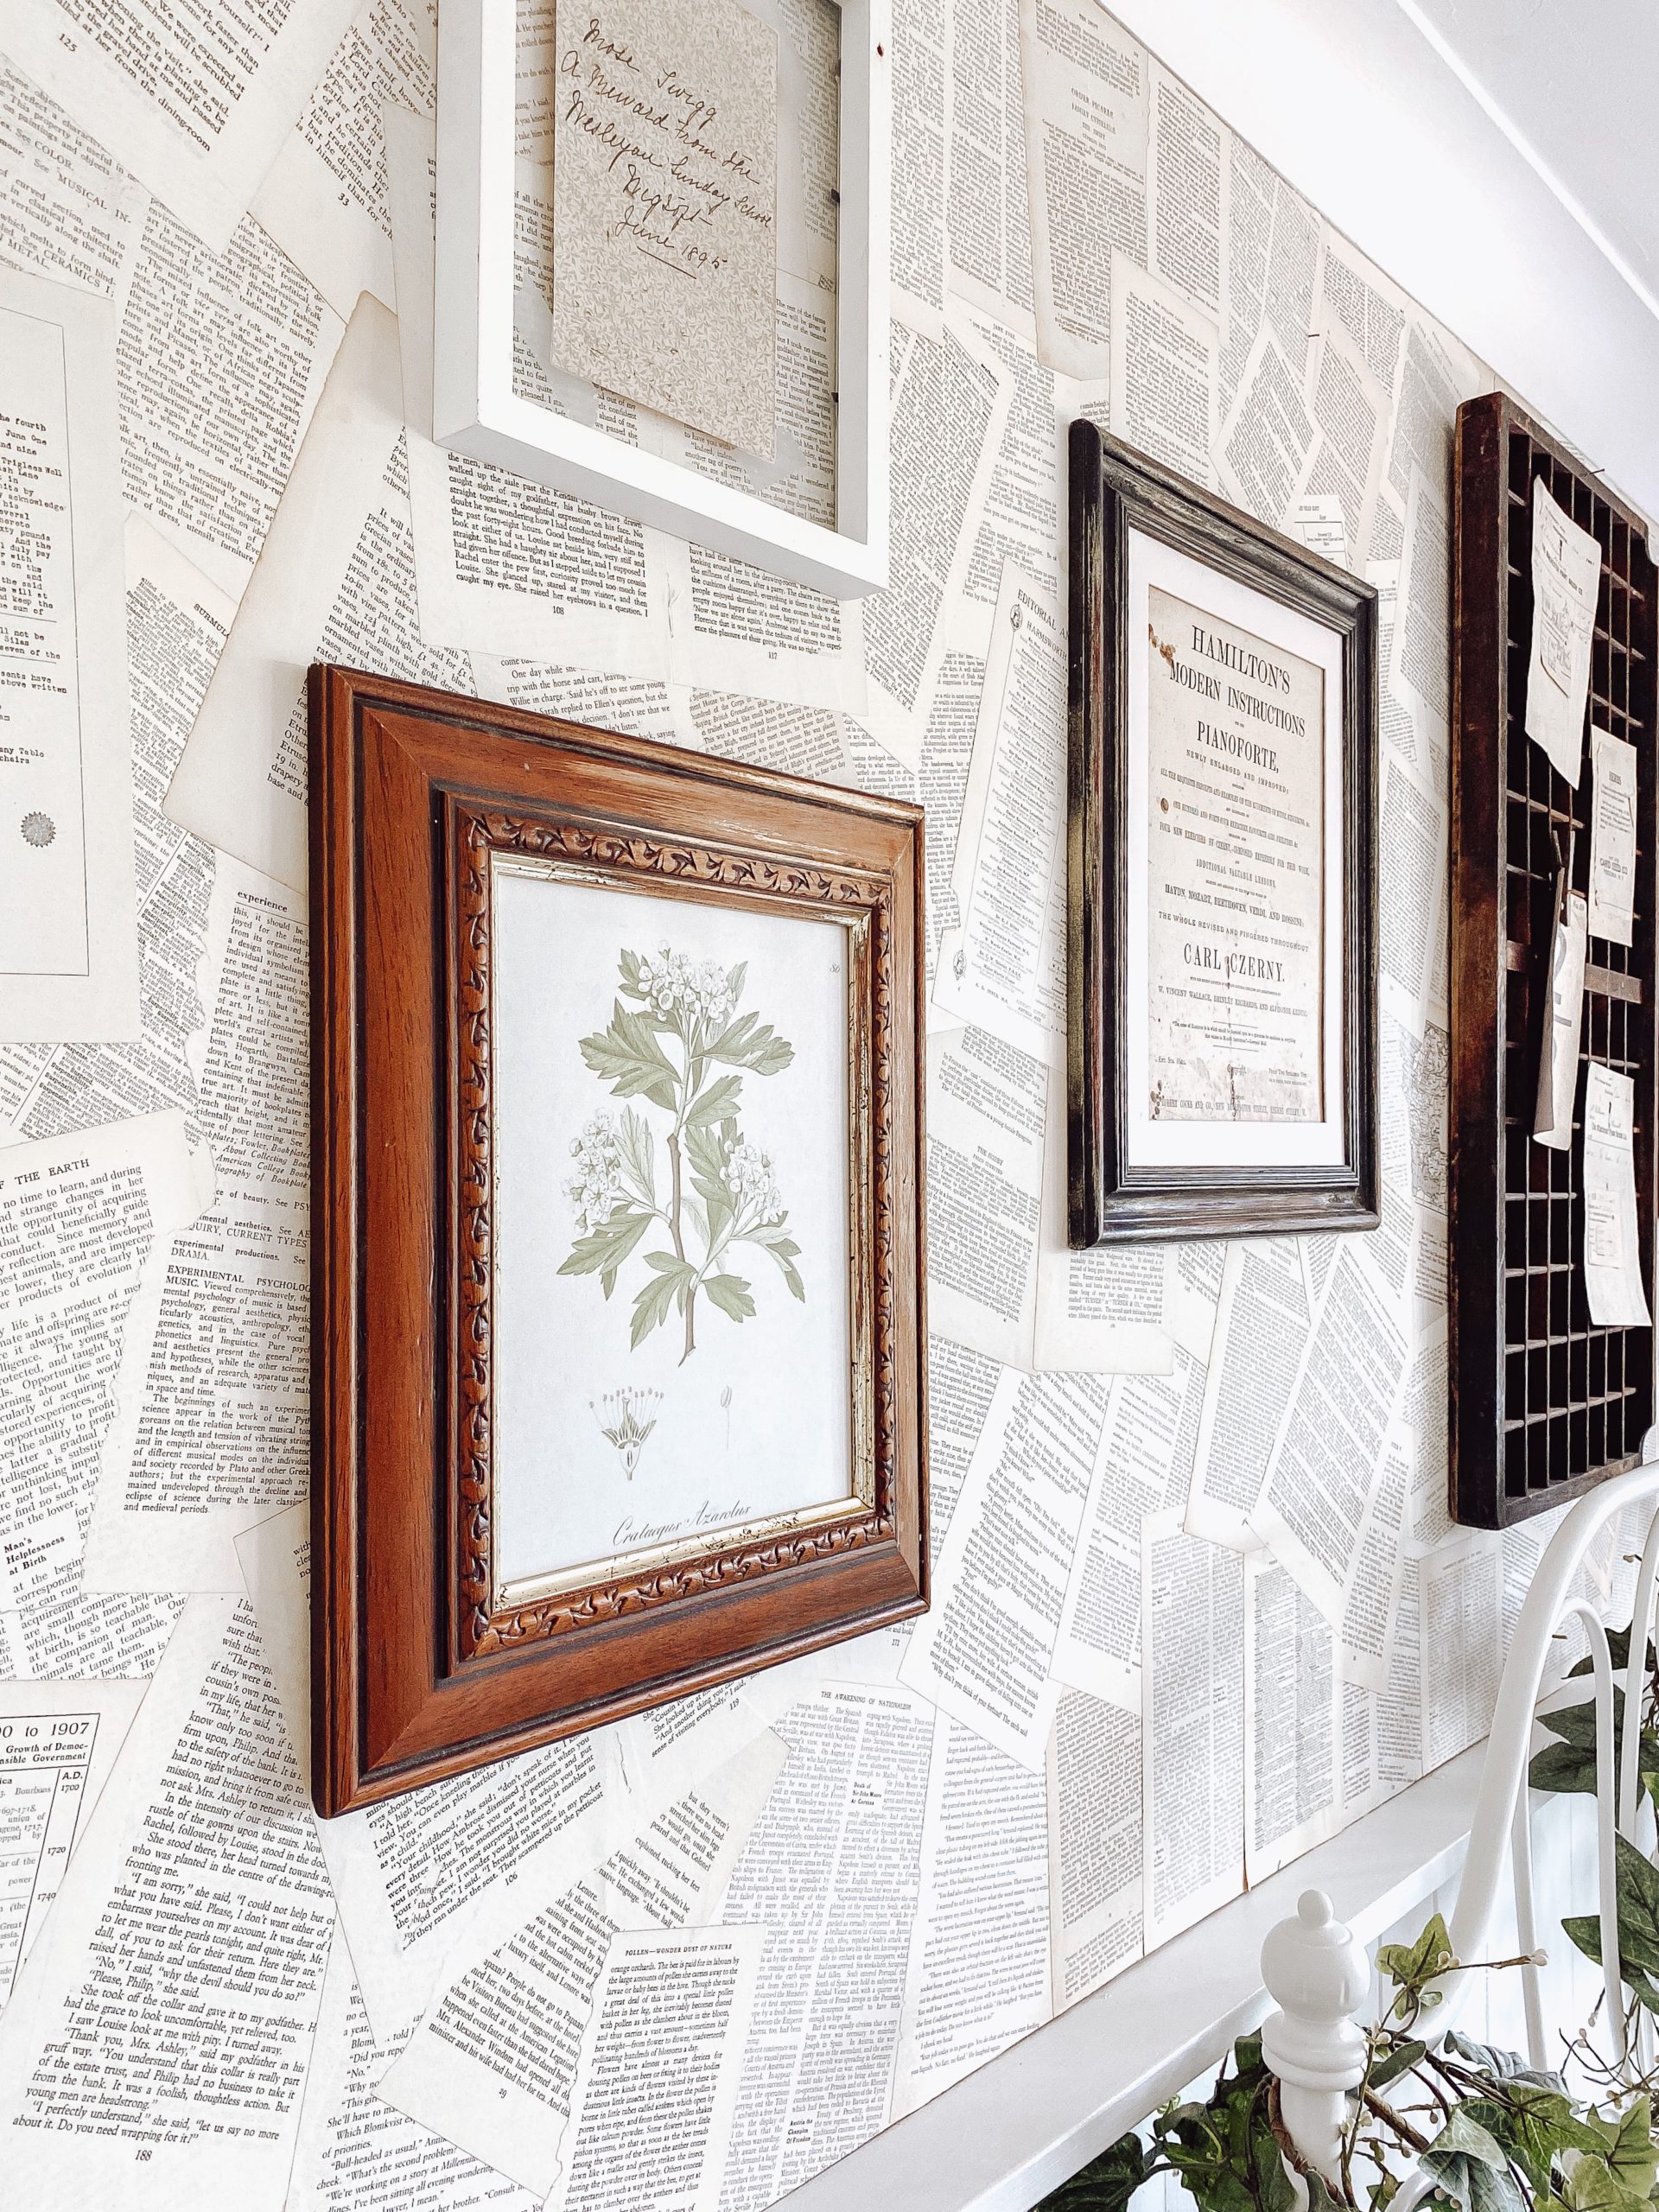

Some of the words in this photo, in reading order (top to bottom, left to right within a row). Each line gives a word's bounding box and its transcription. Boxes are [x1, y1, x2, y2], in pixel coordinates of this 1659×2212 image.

[59, 33, 78, 53] 125
[95, 34, 112, 53] her
[114, 53, 137, 80] from
[141, 79, 156, 97] the
[158, 96, 211, 152] dining-room
[16, 128, 31, 145] See
[35, 140, 74, 172] COLOR.
[316, 145, 347, 181] himself
[347, 183, 365, 206] than
[338, 157, 377, 204] dominates
[57, 173, 107, 210] MUSICAL
[338, 193, 350, 206] 33
[671, 156, 730, 215] Sunday
[734, 196, 772, 228] School
[615, 205, 674, 248] June
[682, 244, 728, 270] 1895
[16, 418, 47, 432] fourth
[6, 429, 26, 441] June
[31, 435, 47, 446] One
[16, 444, 37, 456] nine
[18, 467, 39, 480] Lane
[23, 487, 34, 497] by
[9, 493, 64, 512] acknowledge
[21, 531, 51, 542] pounds
[36, 541, 51, 550] the
[10, 544, 30, 556] duly
[36, 550, 50, 559] pay
[456, 574, 480, 584] caught
[483, 579, 494, 588] my
[514, 583, 527, 593] She
[530, 588, 550, 597] raised
[553, 591, 563, 600] her
[567, 595, 596, 607] eyebrows
[615, 606, 642, 615] question.
[553, 606, 565, 615] 108
[1018, 588, 1057, 631] EDITORIAL
[719, 629, 741, 639] pleasure
[1027, 620, 1067, 661] HARMSWORTH
[768, 652, 777, 660] 117
[1192, 625, 1290, 695] HAMILTON'S
[1170, 659, 1221, 702] MODERN
[1228, 686, 1306, 737] INSTRUCTIONS
[1197, 721, 1280, 773] PIANOFORTE,
[1186, 749, 1207, 764] NEWLY
[1210, 759, 1241, 776] ENLARGED
[1244, 772, 1255, 781] AND
[1196, 858, 1226, 874] ADDITIONAL
[237, 889, 288, 913] experience
[1165, 884, 1186, 898] HAYDN,
[1188, 890, 1212, 906] MOZART,
[1214, 897, 1247, 914] BEETHOVEN,
[1249, 906, 1267, 918] VERDI,
[1268, 911, 1280, 920] AND
[1159, 911, 1172, 921] THE
[1173, 913, 1196, 926] WHOLE
[1198, 920, 1224, 932] REVISED
[1226, 927, 1238, 936] AND
[1239, 930, 1268, 943] FINGERED
[1270, 938, 1309, 953] THROUGHOUT
[1184, 943, 1222, 970] CARL
[1230, 952, 1285, 982] CZERNY.
[1166, 987, 1186, 998] VINCENT
[1189, 990, 1211, 1002] WALLACE,
[15, 1171, 41, 1185] THE
[48, 1158, 90, 1177] EARTH
[3, 1200, 16, 1209] no
[20, 1193, 42, 1204] time
[60, 1182, 88, 1193] learn,
[91, 1174, 108, 1185] and
[111, 1166, 142, 1179] during
[226, 1228, 273, 1243] CURRENT
[277, 1236, 308, 1249] TYPES
[171, 1247, 210, 1261] DRAMA.
[174, 1238, 224, 1252] experimental
[235, 1248, 280, 1261] productions.
[293, 1255, 306, 1265] See
[168, 1265, 245, 1283] EXPERIMENTAL
[3, 1537, 33, 1554] Man's
[6, 1535, 65, 1565] Helplessness
[10, 1567, 18, 1575] at
[22, 1554, 47, 1570] Birth
[879, 1700, 912, 1711] NATIONALISM
[25, 1726, 38, 1738] to
[50, 1722, 89, 1737] 1907
[6, 1745, 40, 1754] Growth
[42, 1744, 53, 1752] of
[55, 1742, 88, 1751] Democ-
[33, 1751, 86, 1762] Government
[62, 1771, 83, 1781] A.D.
[61, 1783, 79, 1793] 1700
[499, 1858, 518, 1875] They
[518, 1830, 553, 1860] scampered
[554, 1822, 563, 1835] up
[563, 1815, 575, 1824] the
[576, 1792, 604, 1818] petticoat
[48, 1846, 66, 1855] 1720
[125, 1857, 162, 1875] fronting
[163, 1868, 178, 1877] me.
[505, 1873, 518, 1886] 106
[37, 1891, 56, 1901] 1740
[577, 1880, 598, 1902] Lenore.
[453, 2021, 486, 2046] Alexander
[488, 2041, 514, 2064] Windom
[519, 2031, 549, 2055] American
[550, 2049, 575, 2072] Legation
[499, 2088, 507, 2099] 29
[12, 2116, 42, 2127] about
[44, 2120, 53, 2129] it.
[57, 2120, 73, 2131] Do
[75, 2125, 94, 2134] you
[96, 2126, 119, 2135] need
[122, 2129, 162, 2143] wrapping
[164, 2132, 178, 2142] for
[44, 2106, 87, 2120] perfectly
[152, 2116, 168, 2126] she
[170, 2120, 189, 2131] said,
[227, 2127, 241, 2137] say
[258, 2131, 279, 2139] more
[336, 2130, 361, 2140] Which
[364, 2118, 403, 2133] Blomkvist
[135, 2150, 152, 2161] 188
[321, 2146, 332, 2158] of
[334, 2140, 372, 2158] priorities.
